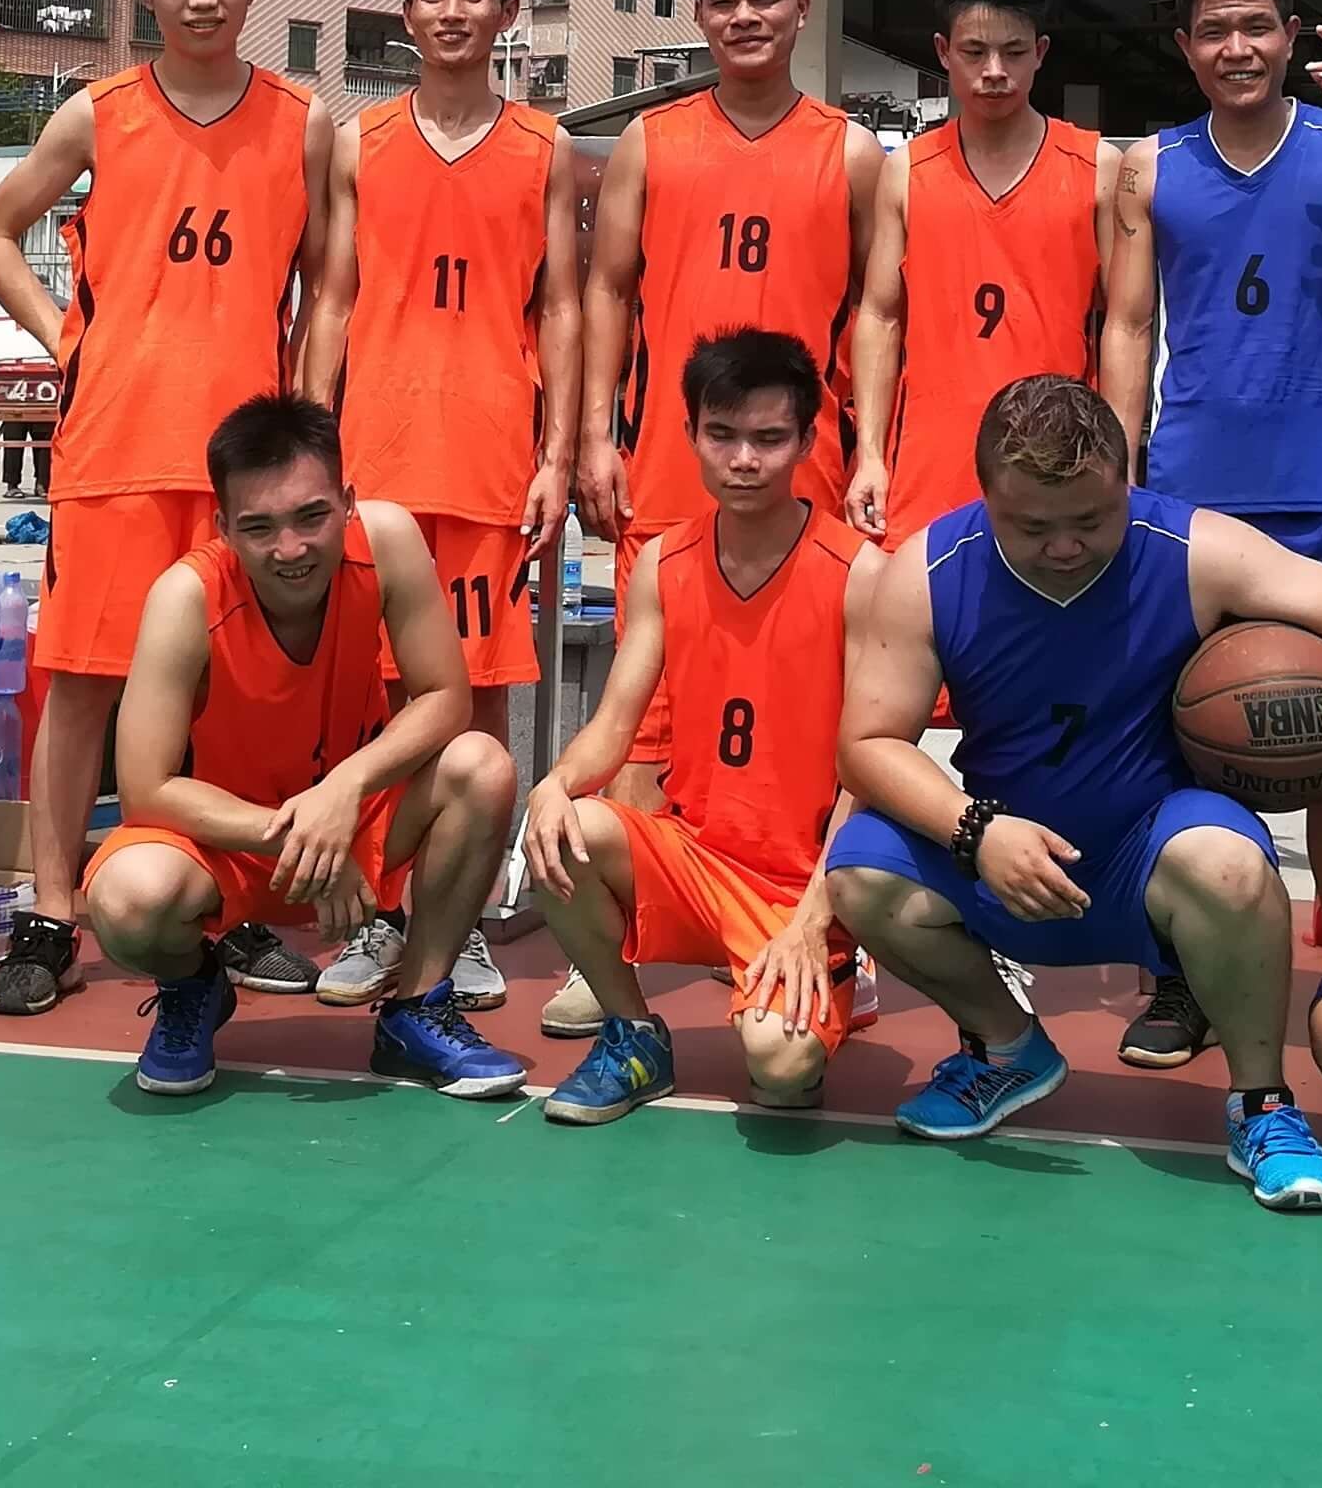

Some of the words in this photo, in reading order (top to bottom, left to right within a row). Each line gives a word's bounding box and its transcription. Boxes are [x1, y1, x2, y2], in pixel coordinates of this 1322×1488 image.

[168, 207, 233, 266] 66
[719, 213, 770, 273] 18
[434, 255, 468, 311] 11
[974, 283, 1005, 339] 9
[1235, 254, 1270, 316] 6
[450, 575, 491, 639] 11
[719, 698, 755, 768] 8
[1046, 703, 1087, 767] 7
[1243, 697, 1315, 739] NBA
